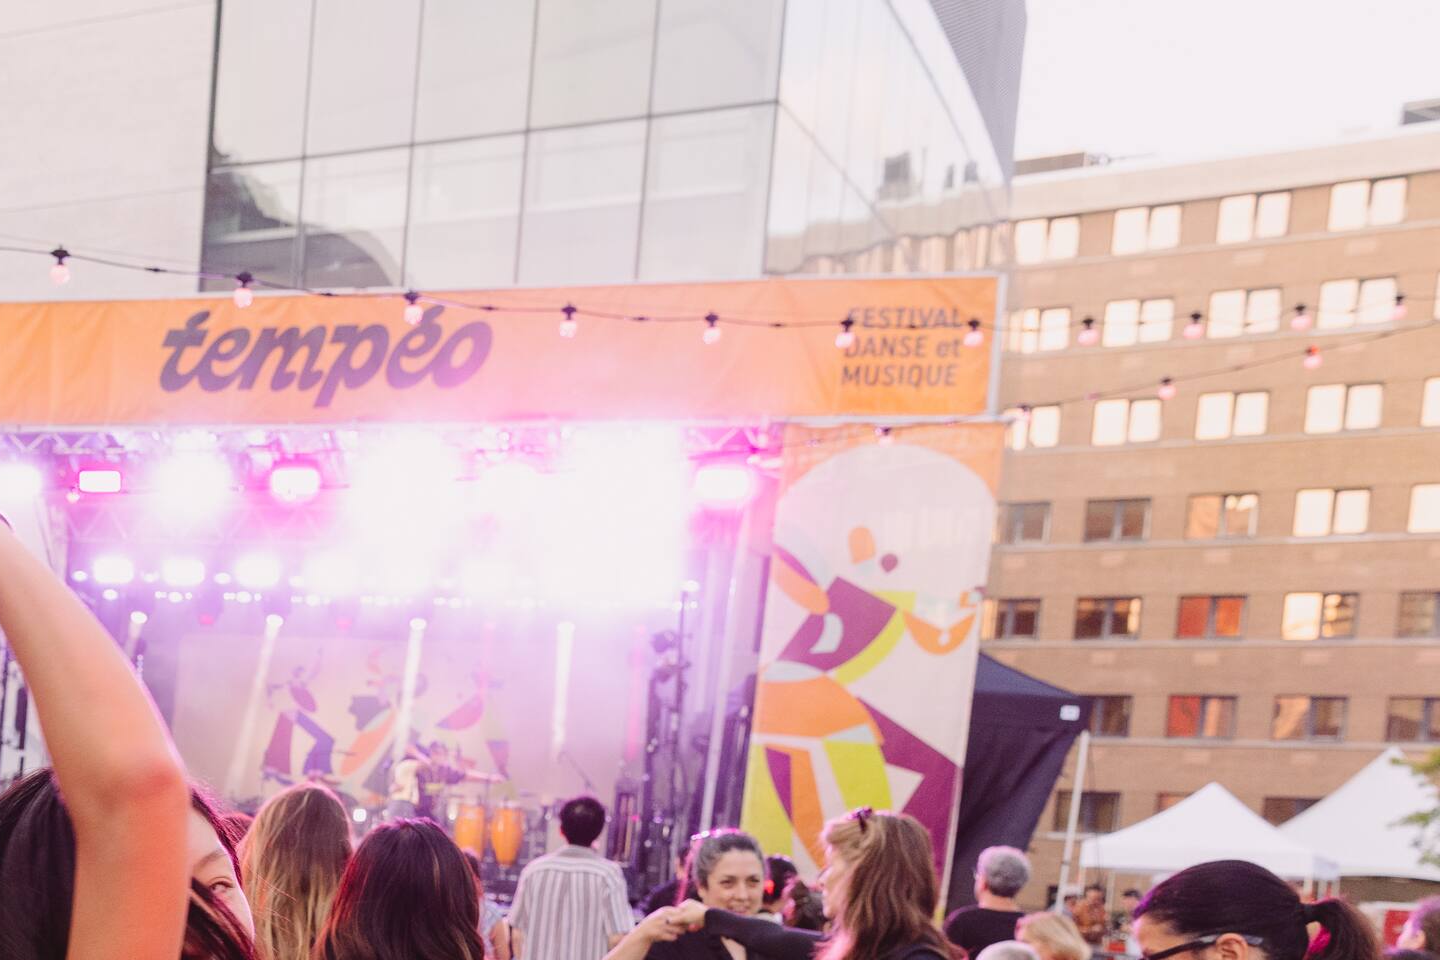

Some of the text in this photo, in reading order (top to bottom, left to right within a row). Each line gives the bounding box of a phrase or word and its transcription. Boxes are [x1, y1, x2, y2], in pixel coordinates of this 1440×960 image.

[160, 305, 493, 408] tempéo
[937, 339, 961, 358] et
[842, 365, 957, 388] MUSIQUE
